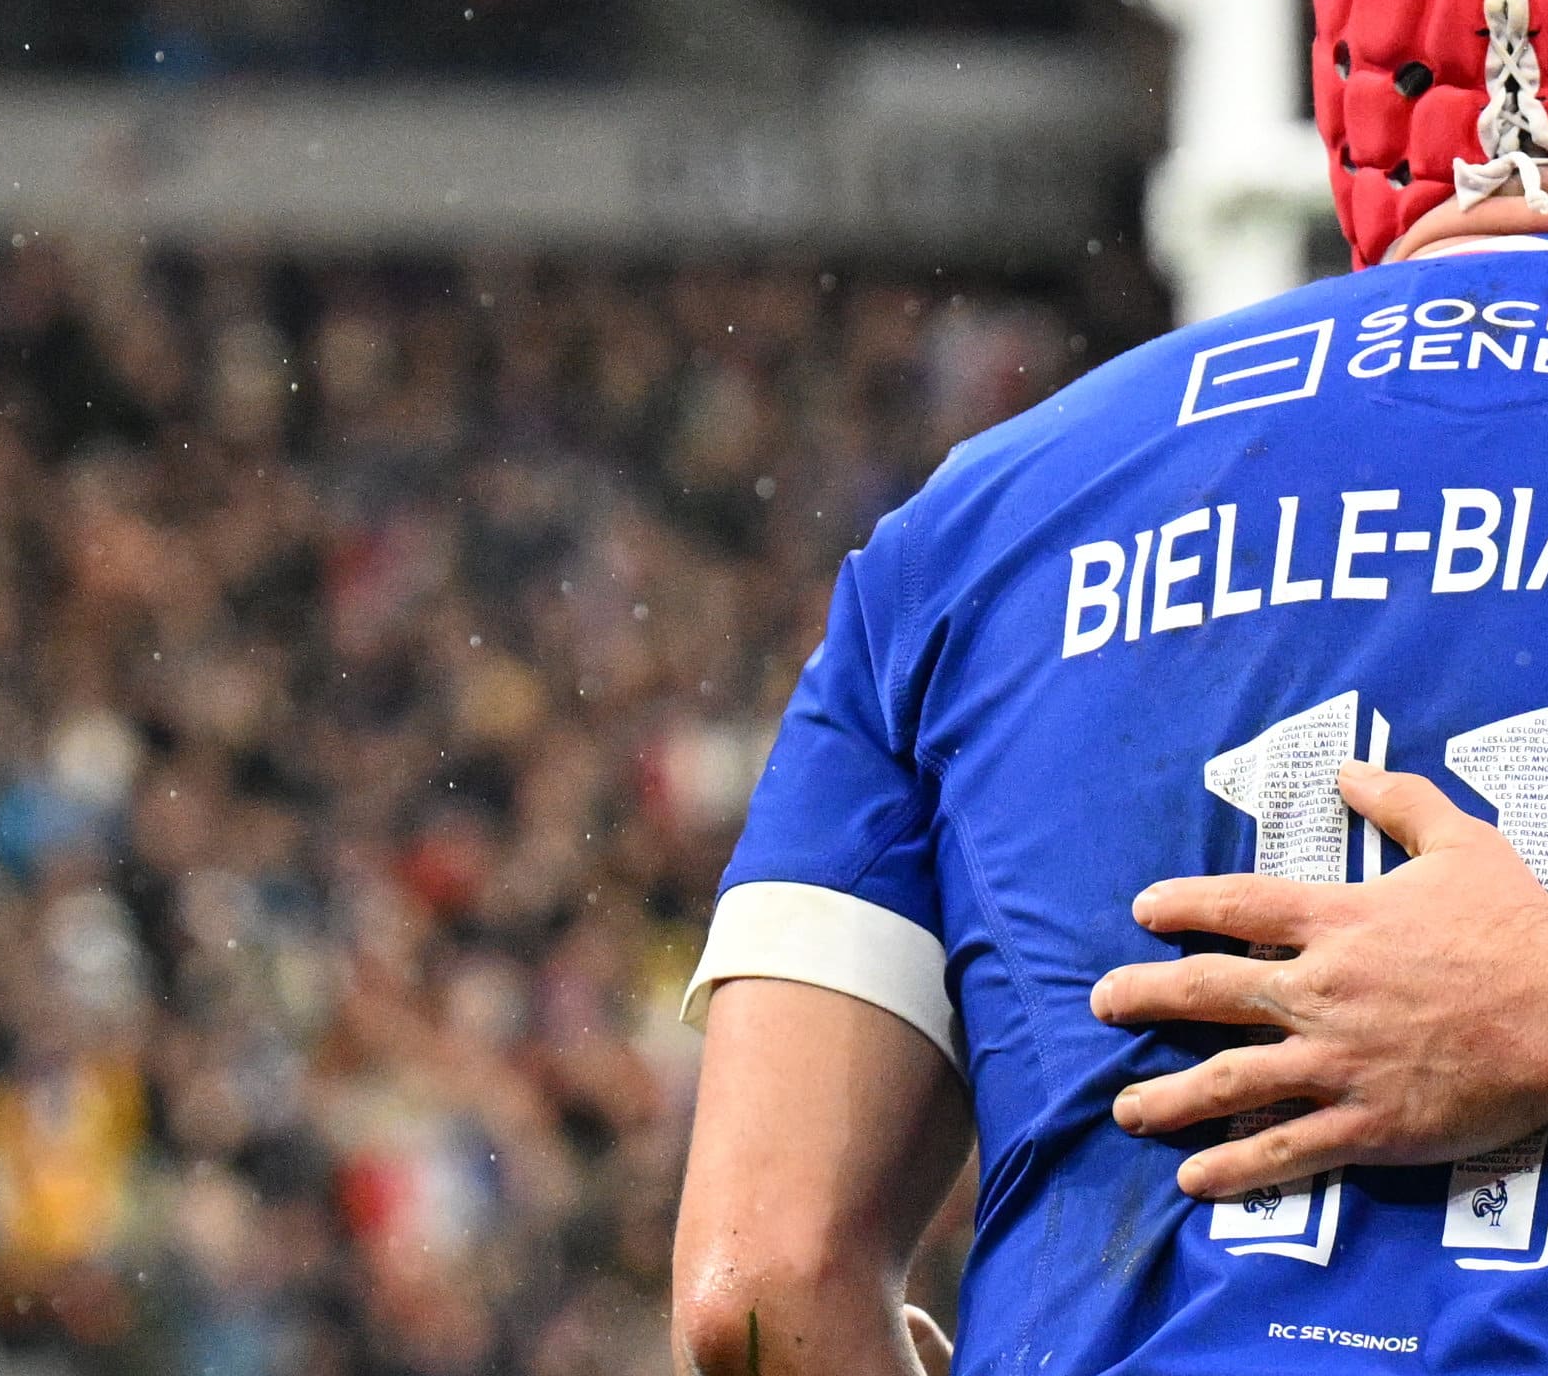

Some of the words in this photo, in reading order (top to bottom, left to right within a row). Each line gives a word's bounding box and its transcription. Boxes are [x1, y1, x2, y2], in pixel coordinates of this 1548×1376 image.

[1506, 726, 1522, 734] LES
[1482, 735, 1498, 744] LES
[1451, 746, 1468, 754] LES
[1471, 745, 1506, 754] MINOTS
[1509, 745, 1522, 753] DE
[1292, 750, 1320, 759] OCEAN
[1451, 754, 1499, 764] MULARDS
[1509, 755, 1528, 763] LES
[1291, 760, 1314, 769] REDS
[1498, 764, 1515, 772] LES
[1481, 773, 1500, 781] LES
[1483, 783, 1507, 791] CLUB
[1517, 783, 1536, 791] LES
[1258, 791, 1287, 799] CELTIC
[1289, 789, 1315, 799] RUGBY
[1317, 787, 1341, 796] CLUB
[1495, 792, 1512, 800] LES
[1269, 801, 1294, 809] DROP
[1298, 797, 1337, 809] GAULOIS
[1262, 811, 1271, 819] LE
[1261, 821, 1284, 830] GOOD
[1261, 831, 1285, 840] TRAIN
[1315, 826, 1342, 835] RUGBY
[1265, 842, 1274, 850] LE
[1260, 851, 1290, 860] RUGBY
[1315, 845, 1341, 853] RUCK
[1299, 874, 1340, 882] ETAPLES
[1268, 1322, 1299, 1340] RC
[1299, 1325, 1419, 1353] SEYSSINOIS
